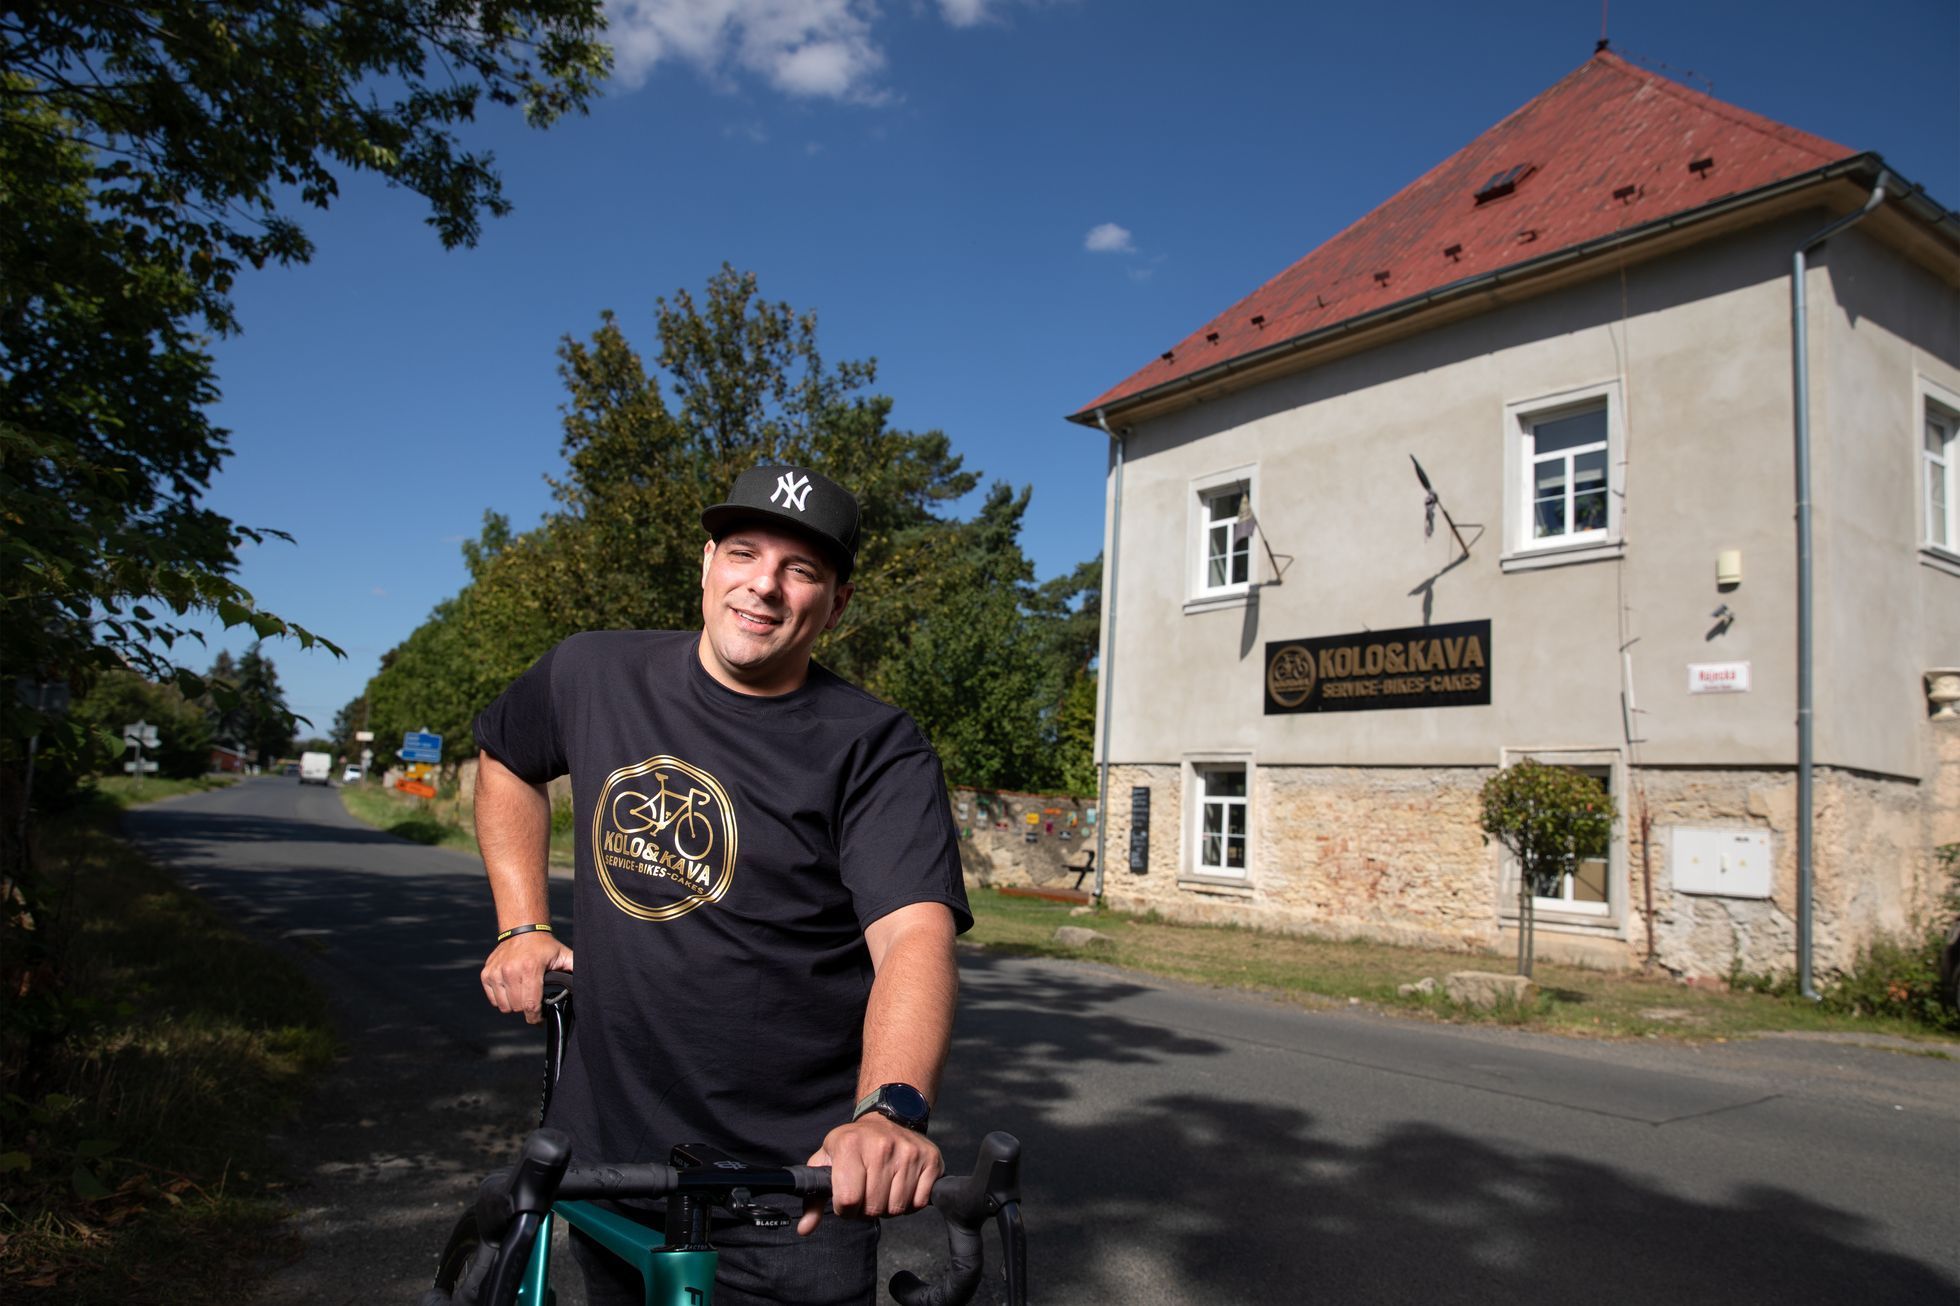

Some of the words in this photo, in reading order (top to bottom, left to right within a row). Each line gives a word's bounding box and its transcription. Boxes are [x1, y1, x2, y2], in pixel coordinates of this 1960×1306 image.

[770, 471, 813, 512] NY
[1318, 635, 1485, 680] KOLO&KAVA
[604, 830, 710, 886] KOLO&KAVA
